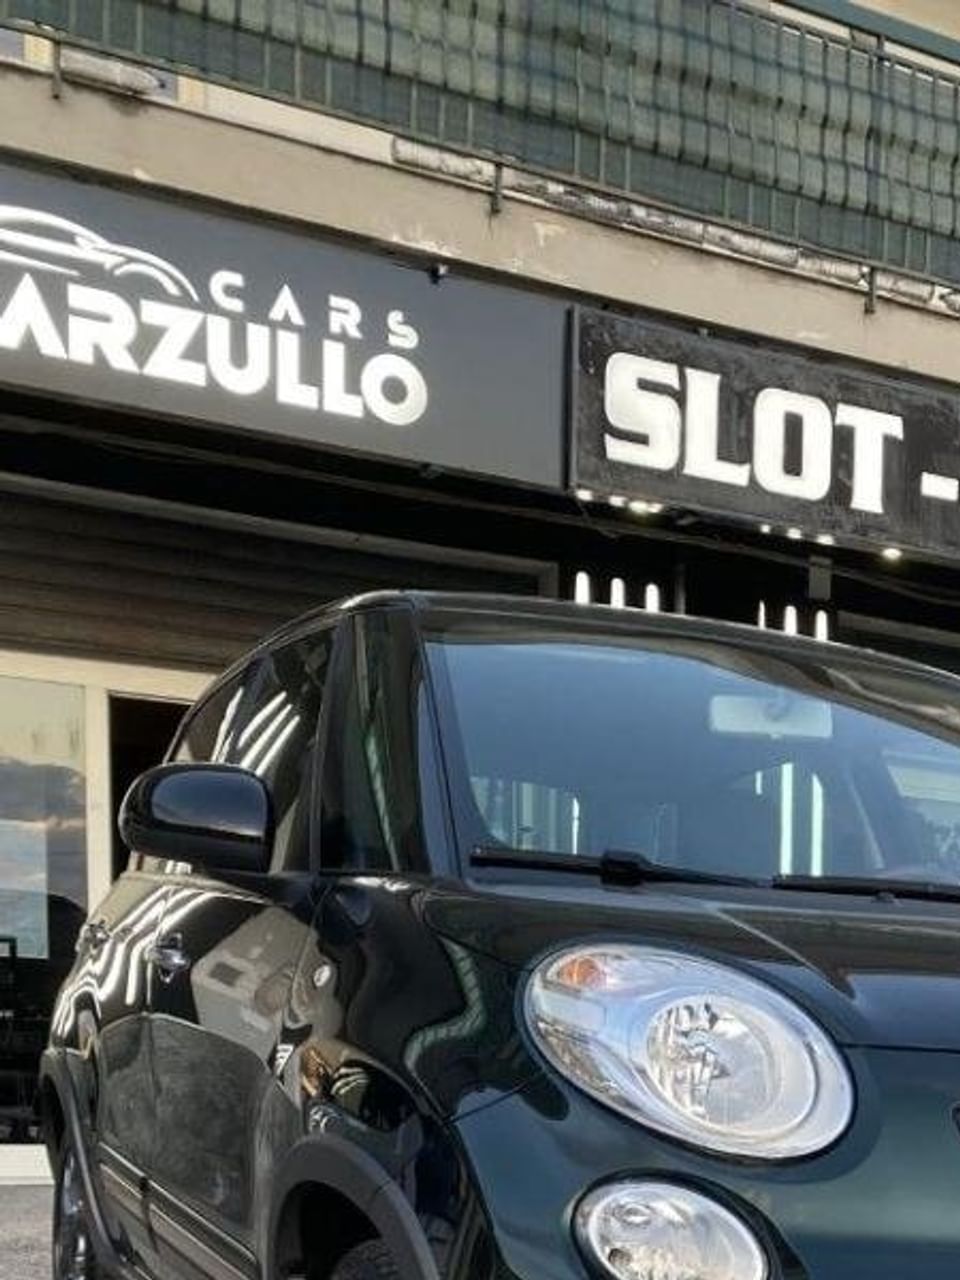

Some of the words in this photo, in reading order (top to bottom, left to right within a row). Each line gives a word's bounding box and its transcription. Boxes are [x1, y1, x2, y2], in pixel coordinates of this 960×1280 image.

[0, 272, 429, 426] ARZULLO
[209, 269, 419, 349] CARS
[604, 352, 904, 514] SLOT
[920, 471, 959, 501] -
